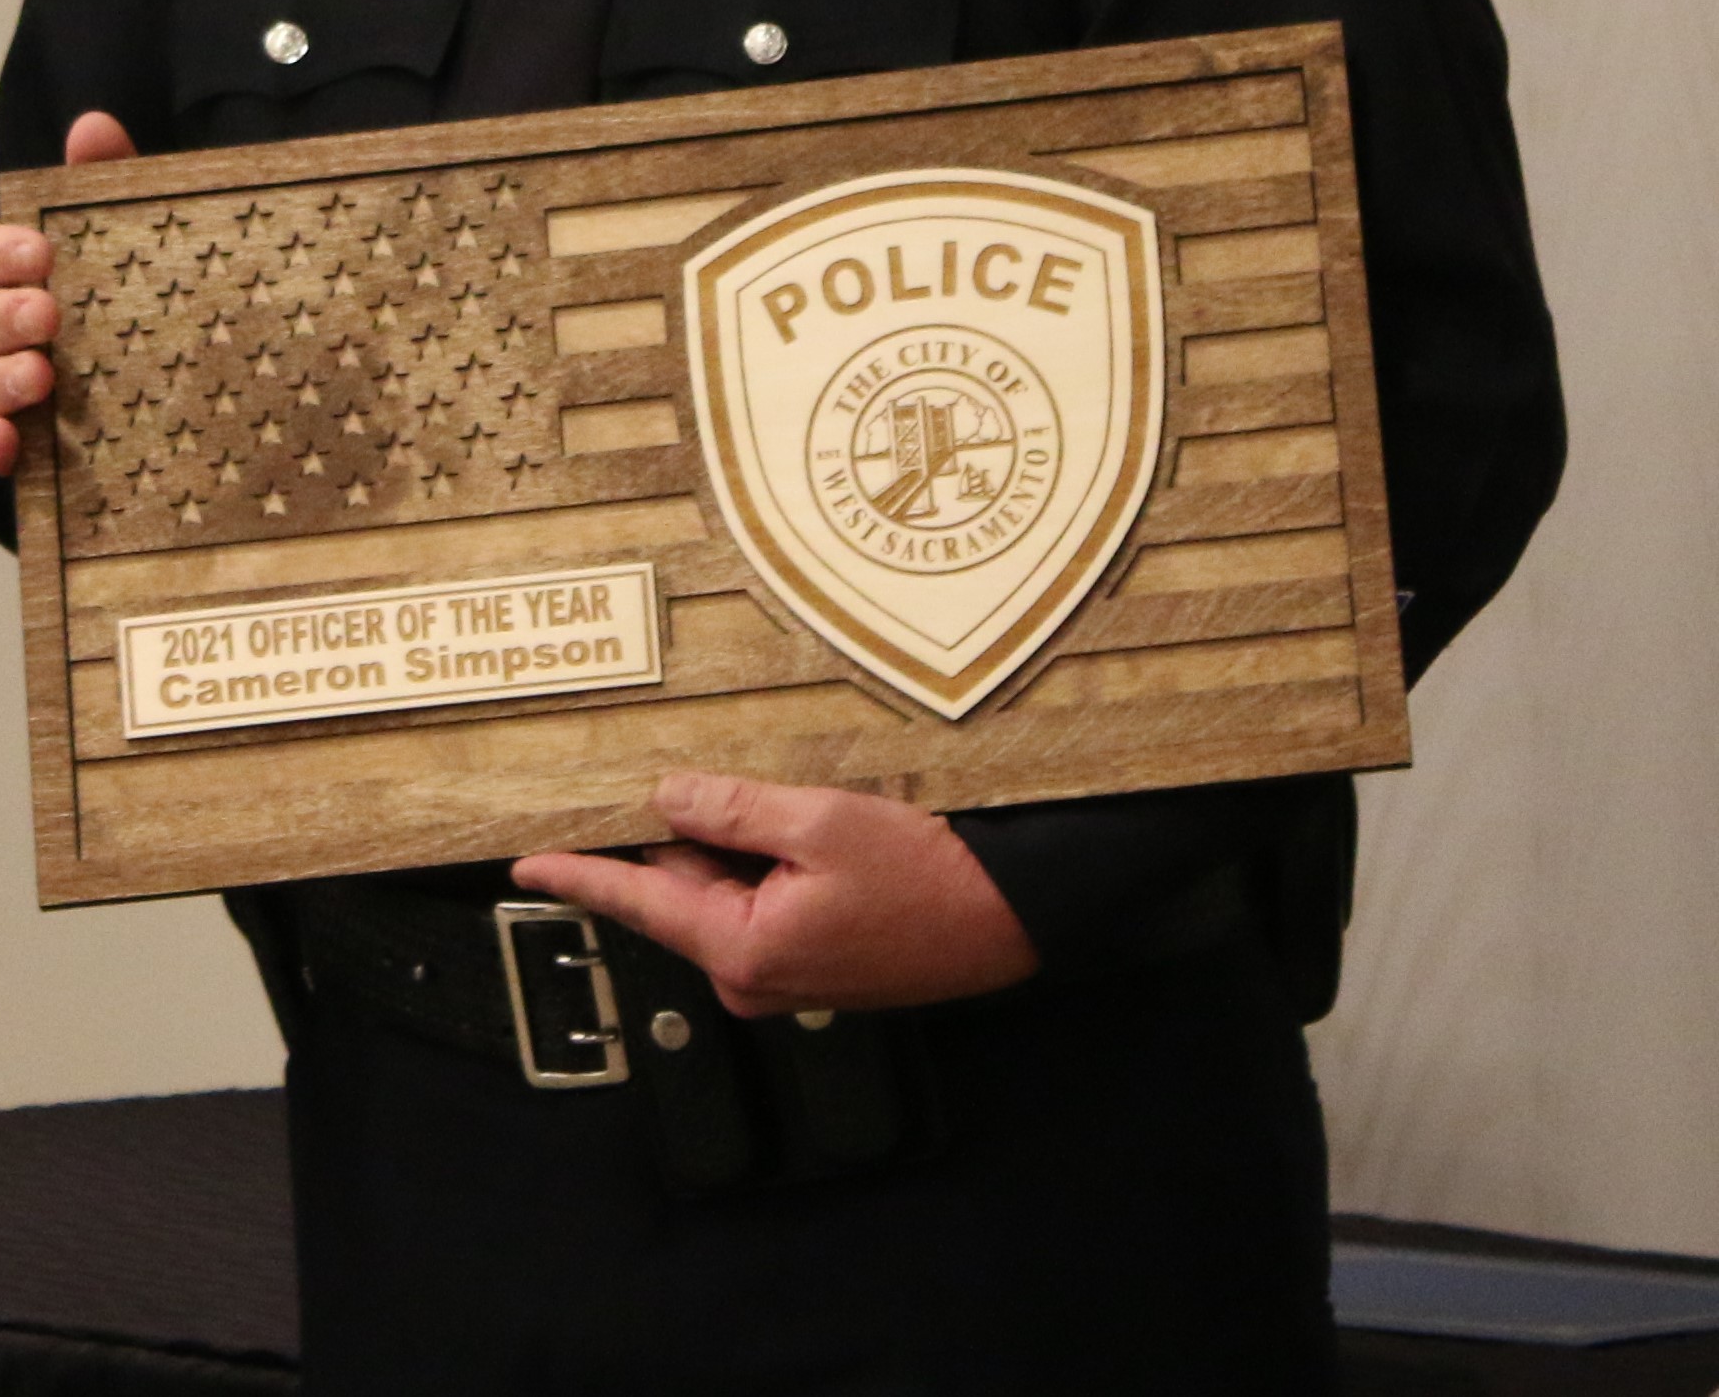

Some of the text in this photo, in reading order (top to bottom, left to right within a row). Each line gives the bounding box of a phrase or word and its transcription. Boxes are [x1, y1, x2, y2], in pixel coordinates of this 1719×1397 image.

[760, 240, 1084, 345] POLICE
[834, 341, 1029, 415] THE CITY OF
[823, 448, 1050, 562] WEST SACRAMENTO
[162, 584, 614, 668] 2021 OFFICER OF THE YEAR
[159, 634, 624, 709] Cameron Simpson
